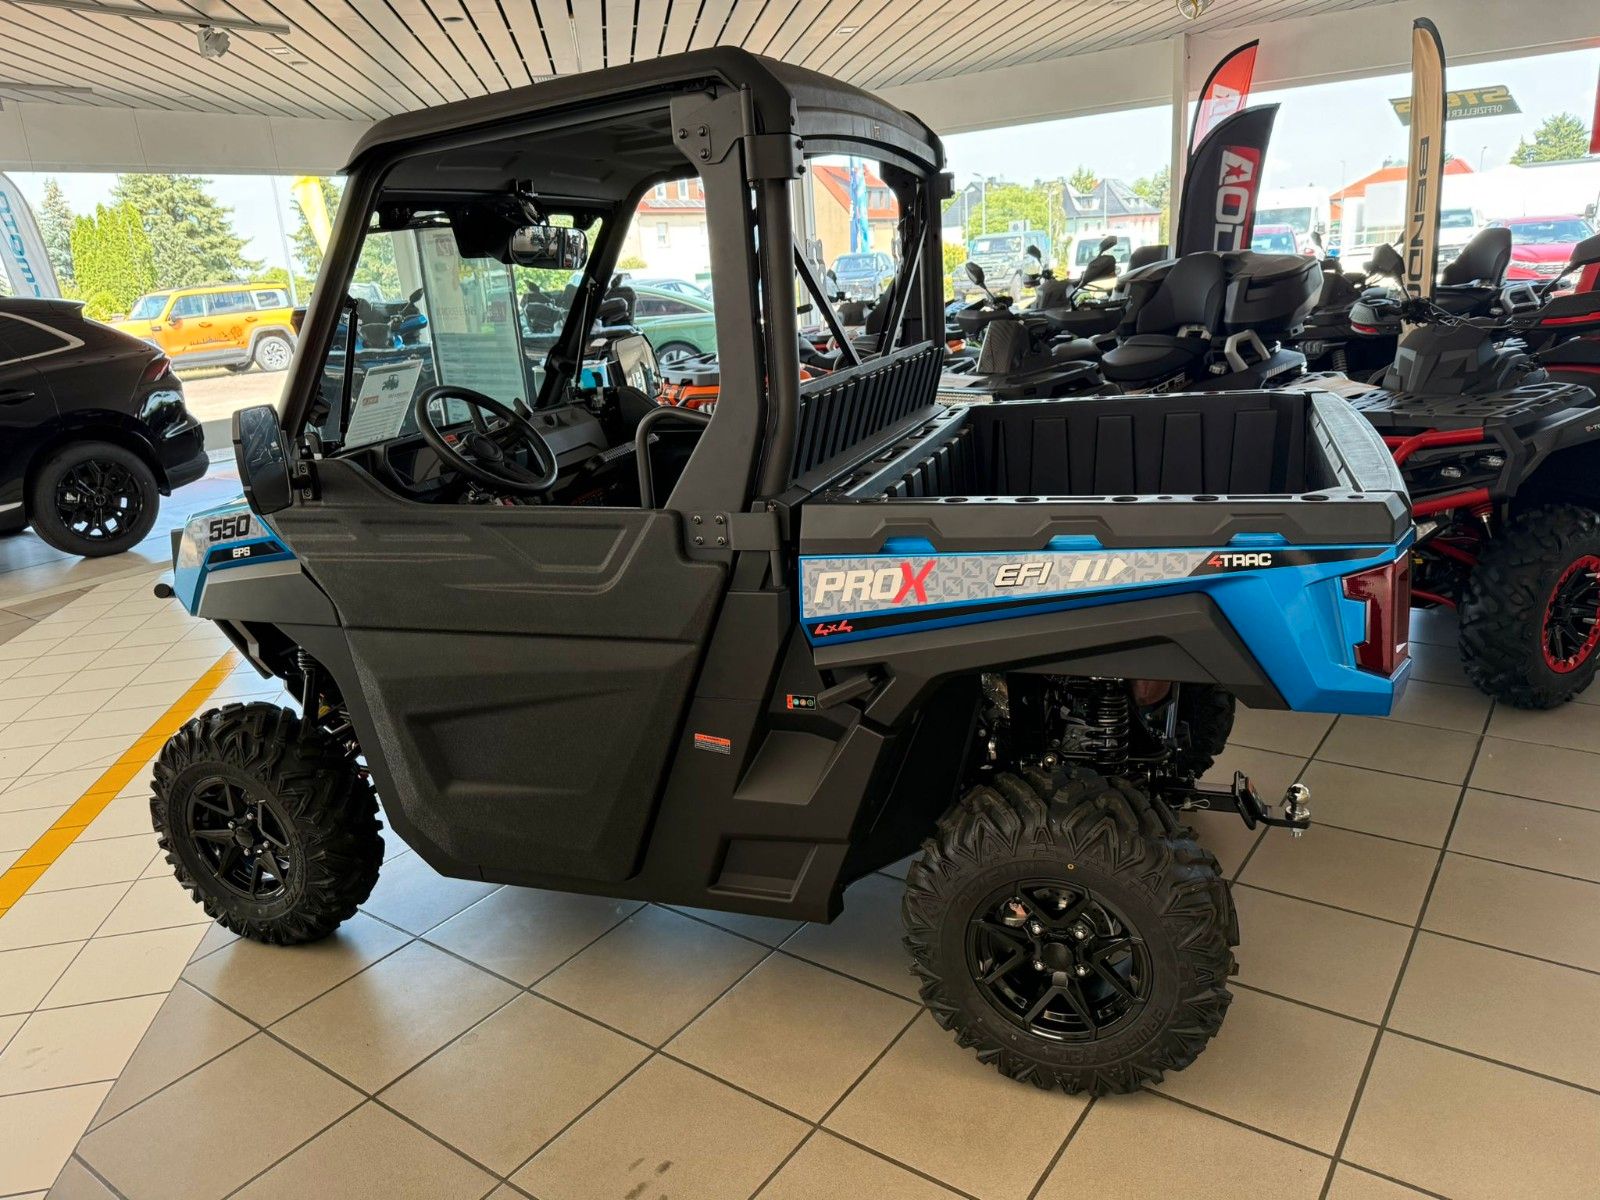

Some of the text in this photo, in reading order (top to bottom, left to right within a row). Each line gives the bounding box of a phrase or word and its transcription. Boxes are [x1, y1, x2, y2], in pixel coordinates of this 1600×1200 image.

[208, 514, 251, 542] 550
[232, 546, 251, 558] EPS
[1207, 553, 1272, 568] 4TRAC
[993, 561, 1053, 588] EFI
